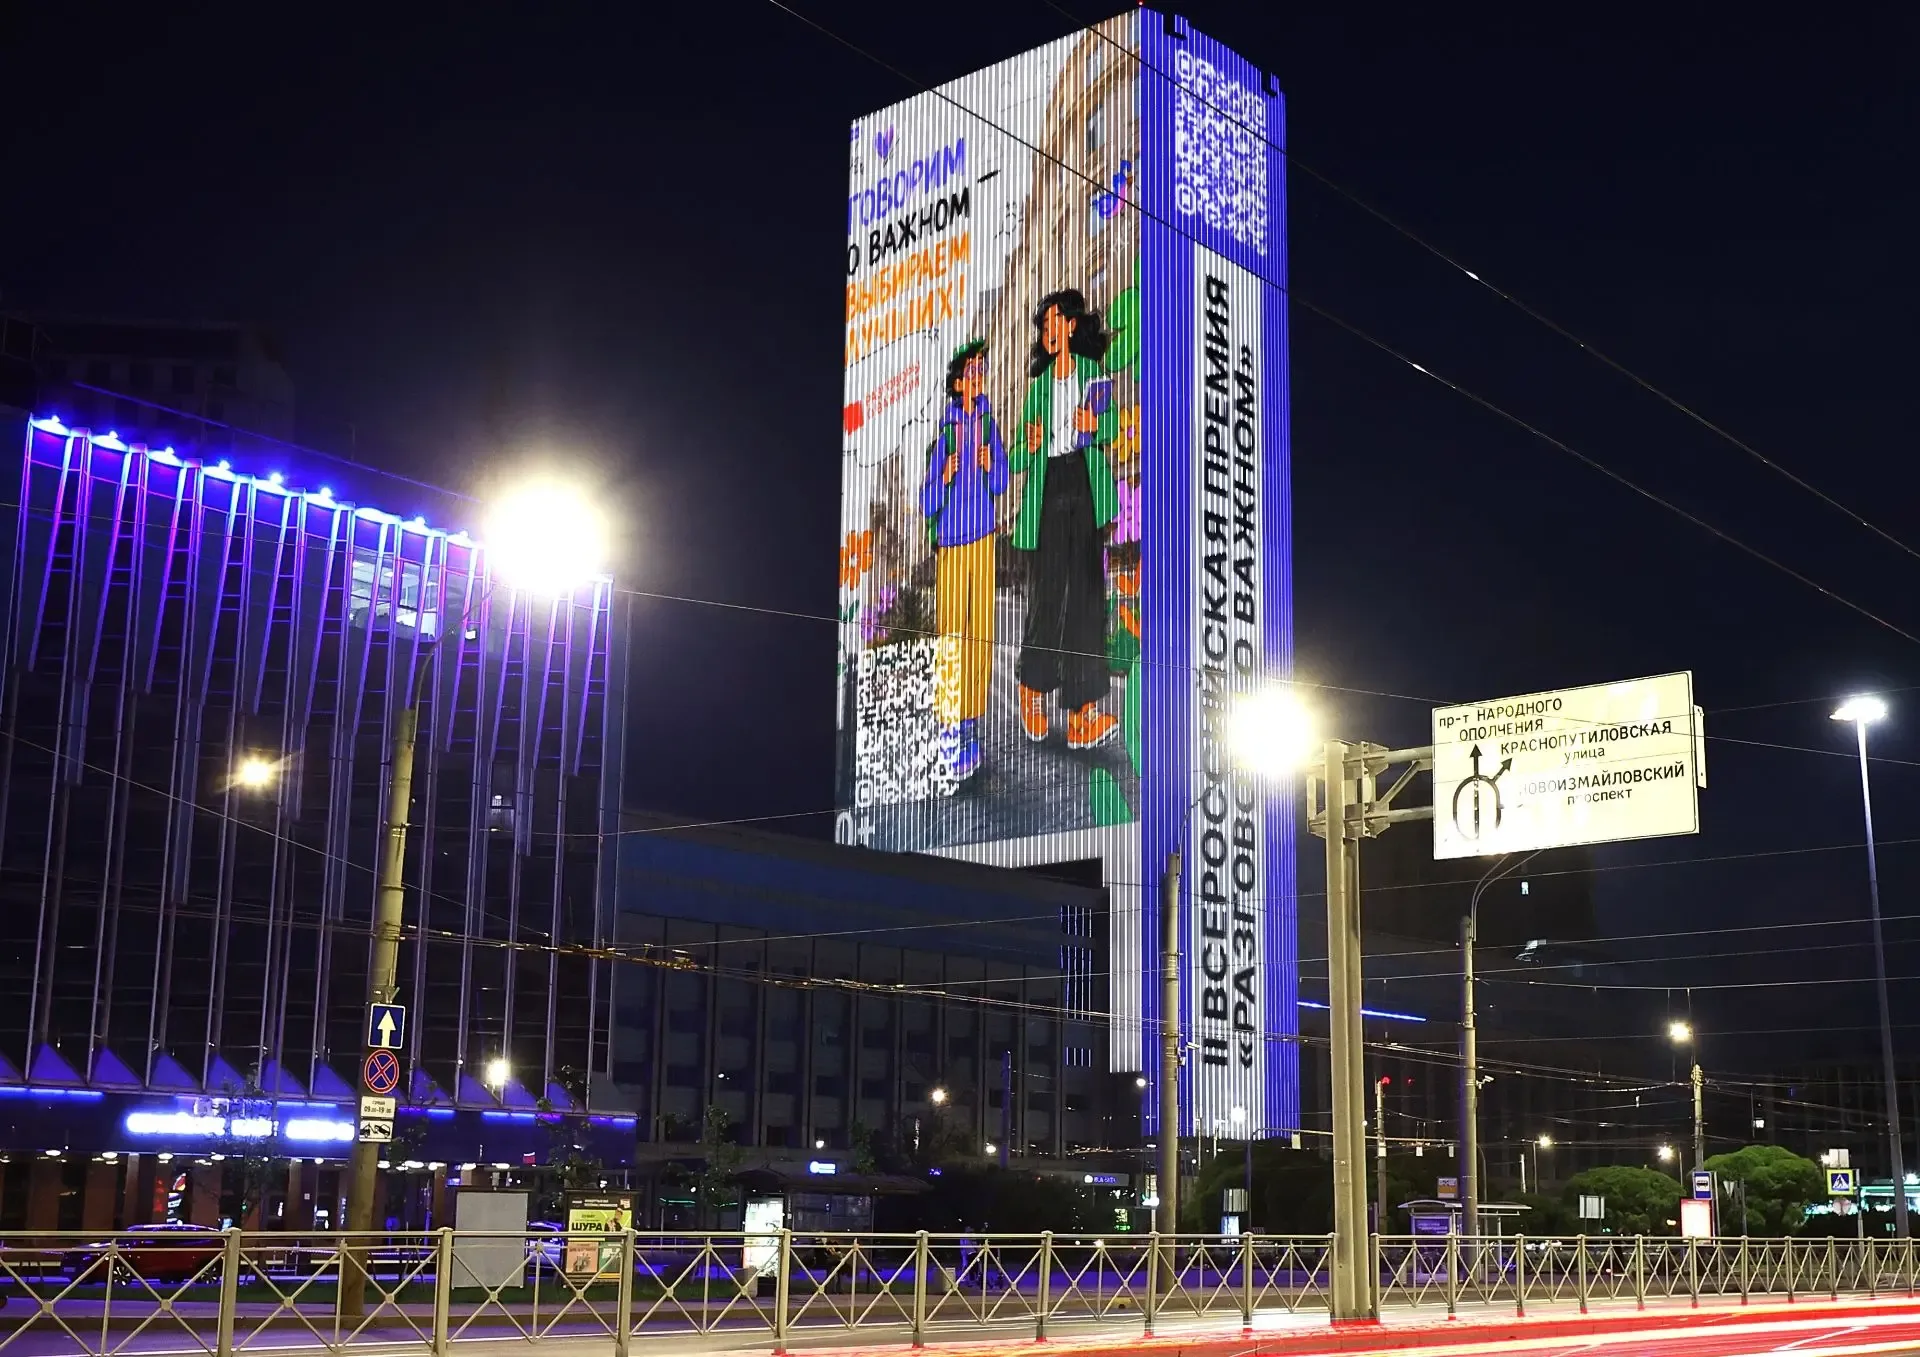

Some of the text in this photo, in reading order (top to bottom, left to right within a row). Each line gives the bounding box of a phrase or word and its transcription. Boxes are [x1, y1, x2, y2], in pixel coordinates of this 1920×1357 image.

[848, 137, 966, 236] ГОВОРИМ
[847, 243, 860, 276] О
[869, 186, 970, 266] ВАЖНОМ
[846, 231, 971, 324] ВЫБИРАЕМ
[845, 272, 965, 368] ЛУЧШИХ!
[1204, 273, 1229, 497] ПРЕМИЯ
[1233, 344, 1256, 1068] «РАЗГОВО О ВАЖНОМ»
[1439, 698, 1563, 729] пр-т НАРОДНОГО
[1459, 718, 1544, 742] ОПОЛЧЕНИЯ
[1500, 720, 1672, 756] КРАСНОПУТИЛОВСКАЯ
[1564, 747, 1606, 764] улица
[1567, 788, 1633, 806] поспект
[571, 1222, 603, 1232] ШУРА
